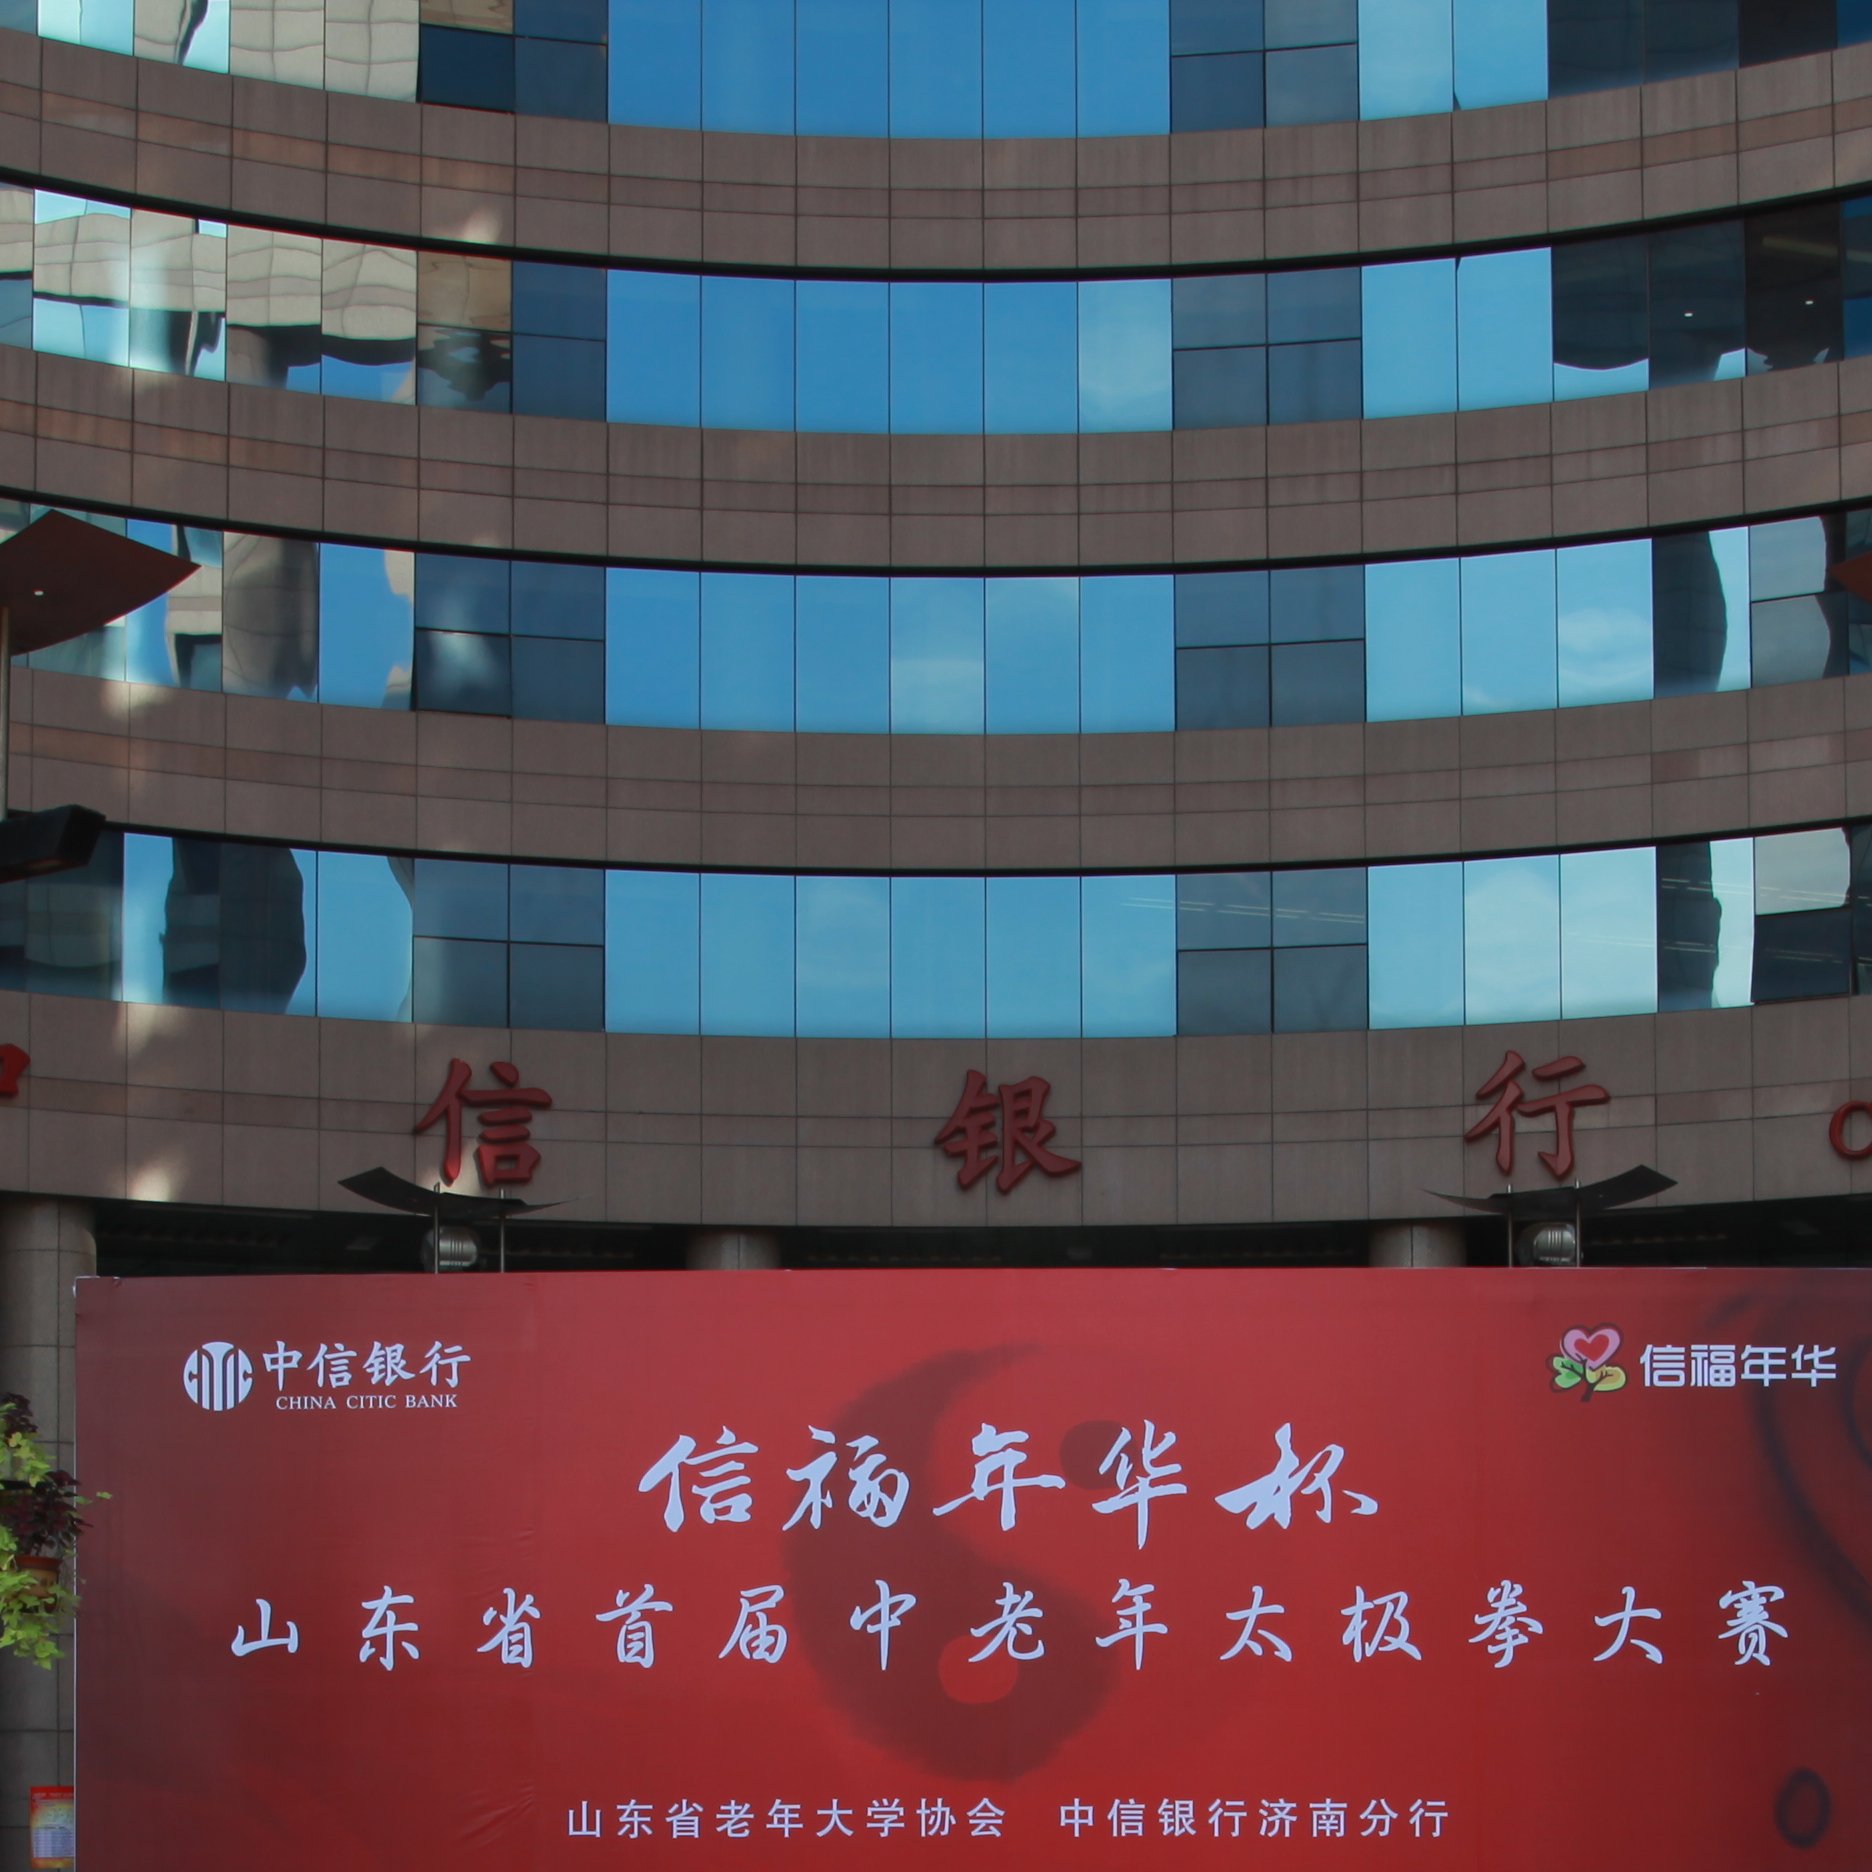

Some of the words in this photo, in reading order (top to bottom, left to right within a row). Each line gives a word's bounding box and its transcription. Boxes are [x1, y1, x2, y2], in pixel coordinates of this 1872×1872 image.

[262, 1340, 472, 1392] 中信银行
[1639, 1343, 1837, 1388] 信福年华
[275, 1395, 337, 1410] CHINA
[346, 1394, 397, 1410] CITIC
[405, 1393, 458, 1409] BANK
[637, 1418, 1380, 1551] 信福年华杯
[230, 1578, 1789, 1672] 山东省首届中老年太极拳大赛
[568, 1797, 1006, 1839] 山东省老年大学协会
[1059, 1797, 1449, 1839] 中信银行济南分行
